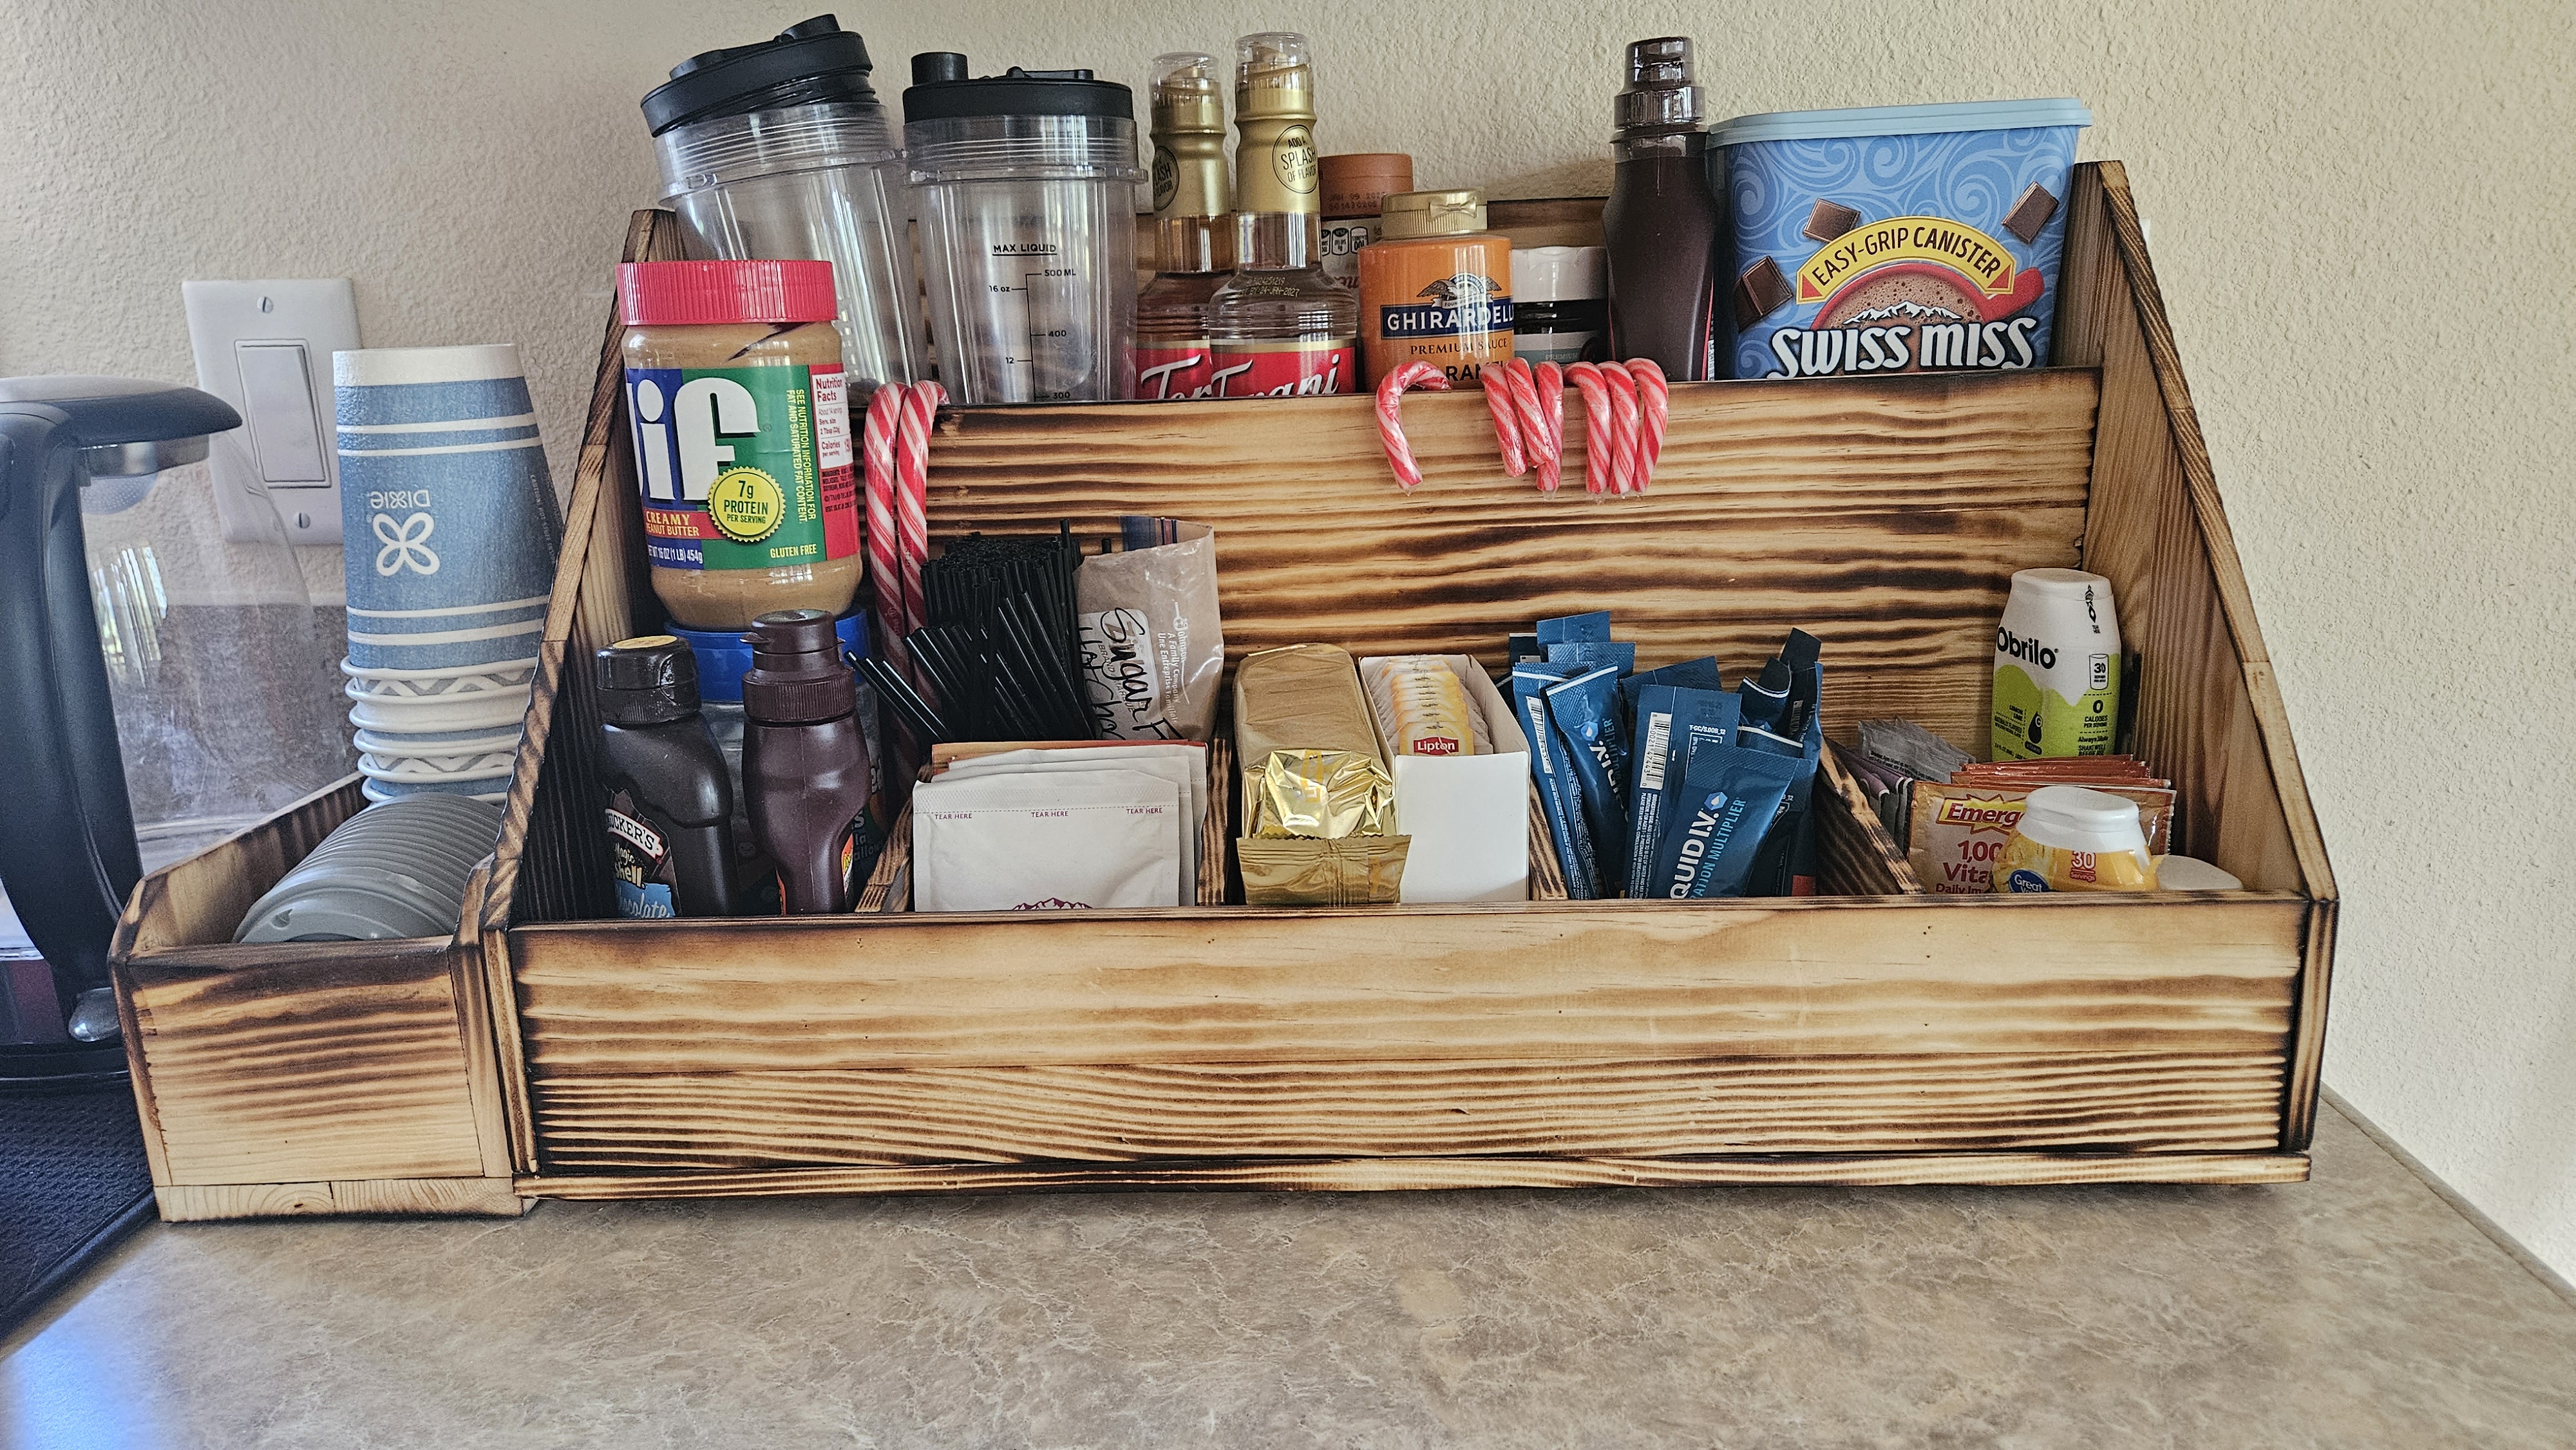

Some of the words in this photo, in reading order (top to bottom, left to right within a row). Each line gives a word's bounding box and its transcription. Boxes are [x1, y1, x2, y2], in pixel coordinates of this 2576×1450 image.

[1288, 137, 1302, 149] ADD
[1302, 136, 1307, 145] A
[1281, 147, 1316, 170] SPLASH
[1287, 171, 1296, 182] OF
[1298, 165, 1316, 180] FLAVOR
[994, 244, 1016, 253] MAX
[1021, 244, 1056, 253] LIQUID
[1812, 227, 1908, 287] EASY-GRIP
[1913, 226, 2002, 279] CANISTER
[1387, 305, 1514, 332] GHIRARDELL
[1411, 343, 1473, 355] PREMIUM
[1479, 338, 1507, 350] SAUCE
[1766, 326, 1911, 379] SWISS
[1920, 317, 2036, 370] MISS
[787, 390, 795, 404] FAT
[796, 390, 805, 404] SEE
[817, 390, 837, 402] Facts
[788, 405, 798, 422] AND
[798, 407, 810, 449] NUTRITION
[627, 379, 761, 502] if
[790, 423, 802, 469] SATURATED
[822, 440, 840, 450] Calories
[795, 471, 804, 484] FAT
[802, 450, 815, 502] INFORMATION
[738, 480, 753, 498] 7g
[724, 500, 768, 515] PROTEIN
[796, 485, 808, 523] CONTENT.
[807, 504, 817, 520] FOR
[646, 511, 690, 525] CREAMY
[741, 515, 766, 524] SERVING
[667, 525, 699, 536] BUTTER
[687, 549, 703, 564] 454g
[770, 546, 799, 559] GLUTEN
[800, 543, 817, 556] FREE
[1169, 641, 1180, 668] Family
[1997, 627, 2056, 669] Obrilo
[1099, 645, 1115, 672] BRAND
[1101, 607, 1152, 722] Sugar
[1160, 650, 1173, 690] Entreprise
[2094, 663, 2106, 673] 30
[2093, 700, 2103, 713] 0
[1417, 740, 1455, 752] Lipton
[1643, 751, 1653, 773] 47443
[606, 813, 654, 850] UCKER'S
[1707, 800, 1747, 860] MULTIPLIER
[1670, 839, 1705, 899] QUID
[1689, 810, 1719, 838] I.V.
[2072, 851, 2096, 869] 30
[615, 862, 643, 887] Shell
[1943, 862, 1989, 883] Vita
[2070, 872, 2096, 883] Servings
[1936, 883, 1965, 894] Daily
[2014, 874, 2042, 892] Great
